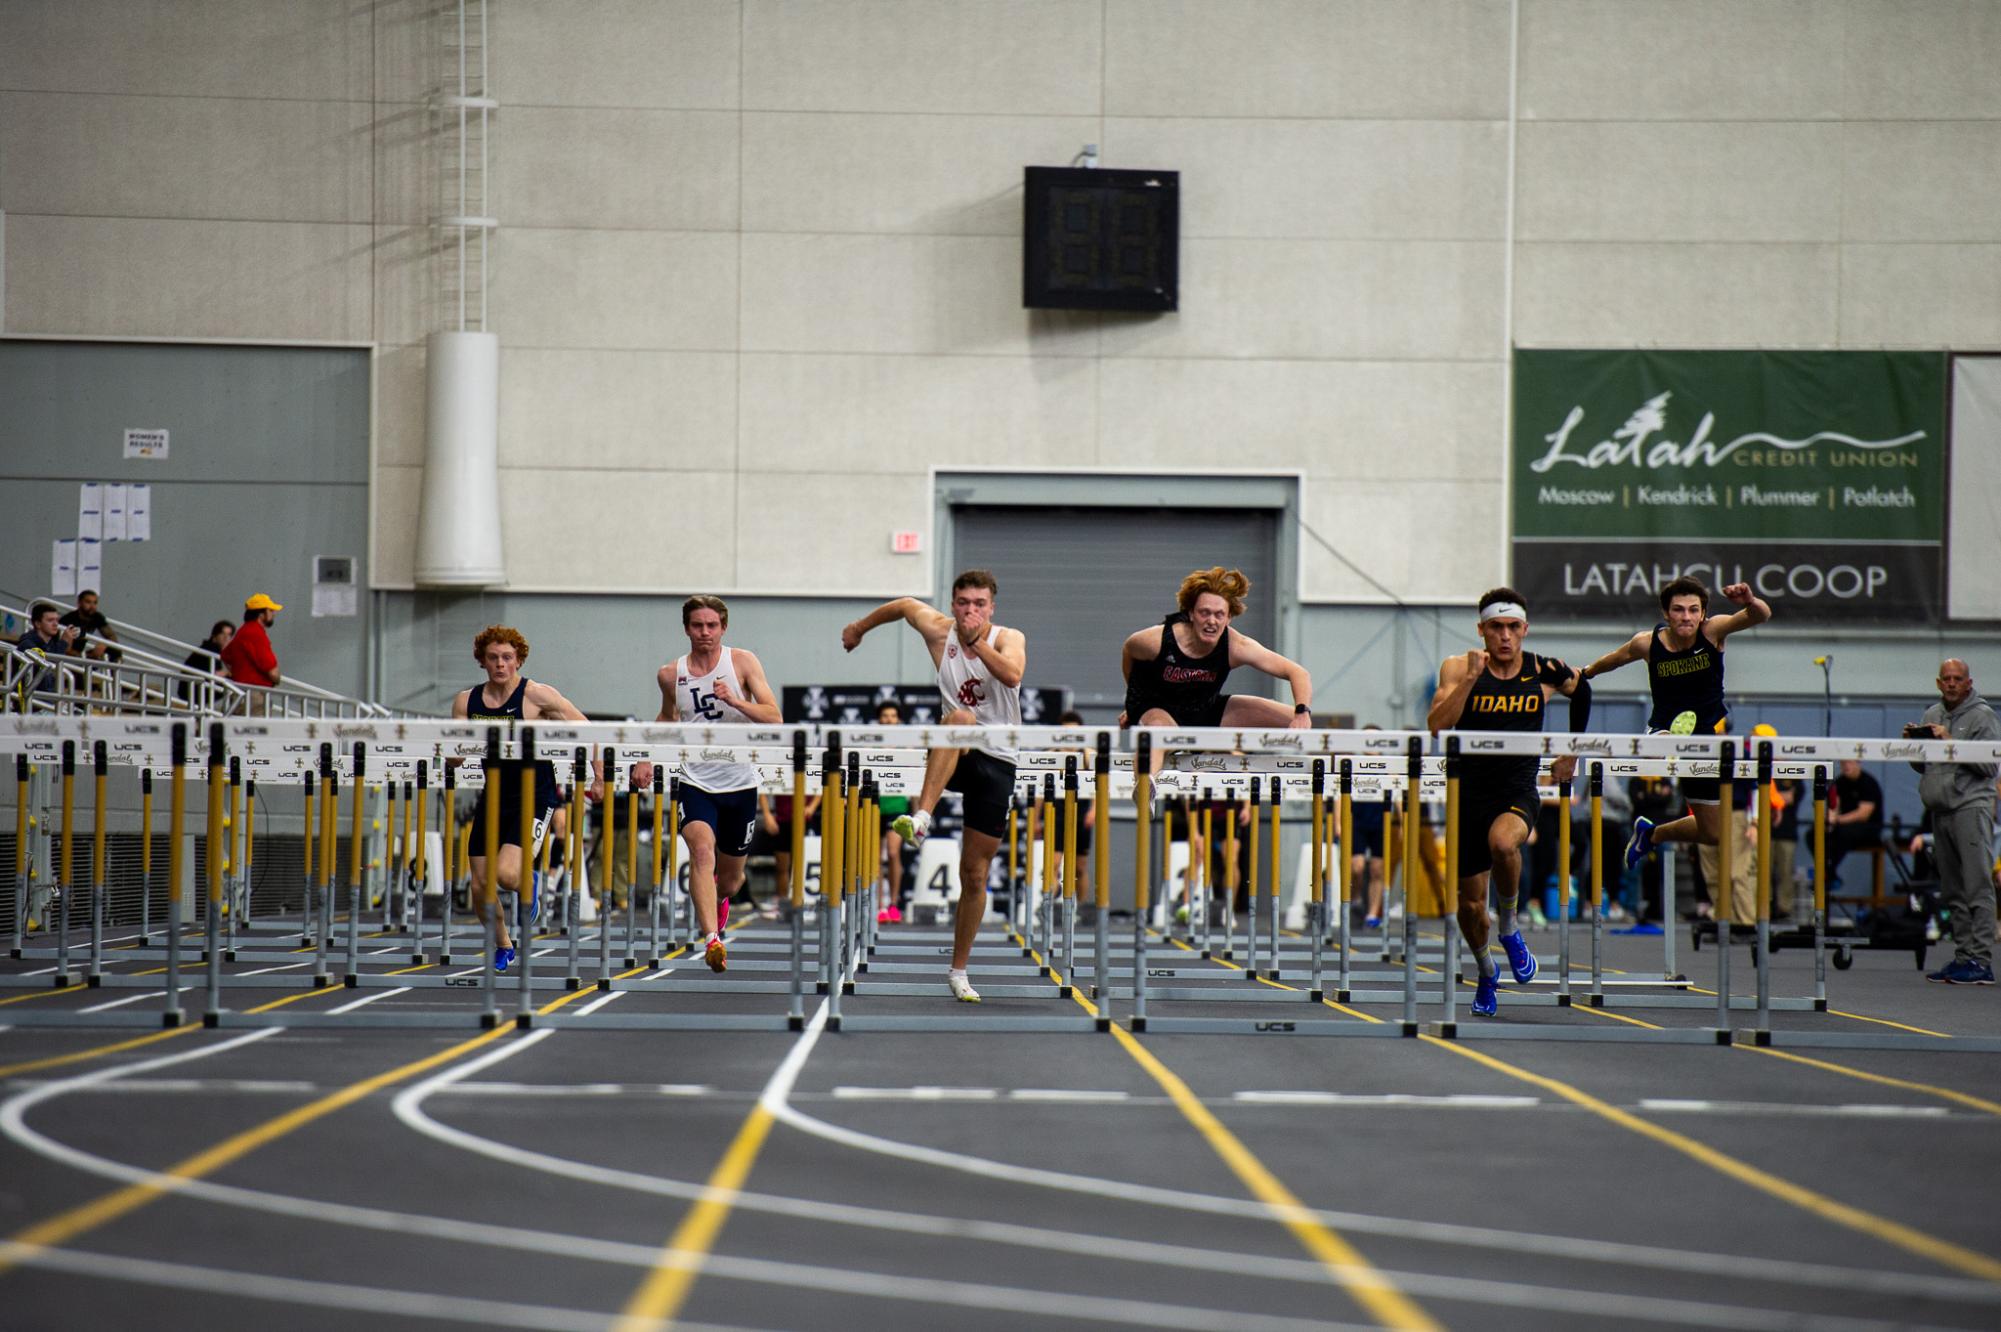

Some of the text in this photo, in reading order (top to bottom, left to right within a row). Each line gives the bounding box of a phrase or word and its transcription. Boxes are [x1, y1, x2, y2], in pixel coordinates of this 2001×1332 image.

[1530, 390, 1752, 473] Latah
[1732, 451, 1918, 467] CREDIT UNION
[1538, 482, 1915, 508] Moscow Kendrick Plummer Potlatch
[1657, 653, 1710, 677] SPOKANE
[1472, 695, 1539, 713] IDAHO
[125, 725, 160, 734] UCS
[233, 726, 268, 735] UCS
[441, 727, 475, 738] UCS
[544, 730, 578, 739] UCS
[748, 733, 781, 741] UCS
[851, 734, 885, 743] UCS
[1052, 735, 1086, 743] UCS
[1163, 736, 1197, 744] UCS
[1365, 739, 1399, 748] UCS
[375, 745, 403, 753] UCS
[1470, 740, 1505, 749] UCS
[1676, 744, 1711, 753] UCS
[1781, 743, 1927, 761] UCS Vandals
[106, 754, 133, 764] andals
[701, 750, 736, 762] Vandals
[1191, 757, 1227, 770] Vandals
[1689, 762, 1720, 776] Vanda
[1776, 767, 1805, 775] UCS
[1155, 776, 1179, 787] andals
[535, 822, 543, 838] 6
[805, 862, 821, 895] 5
[929, 863, 951, 894] 4
[1256, 1022, 1296, 1032] UCS
